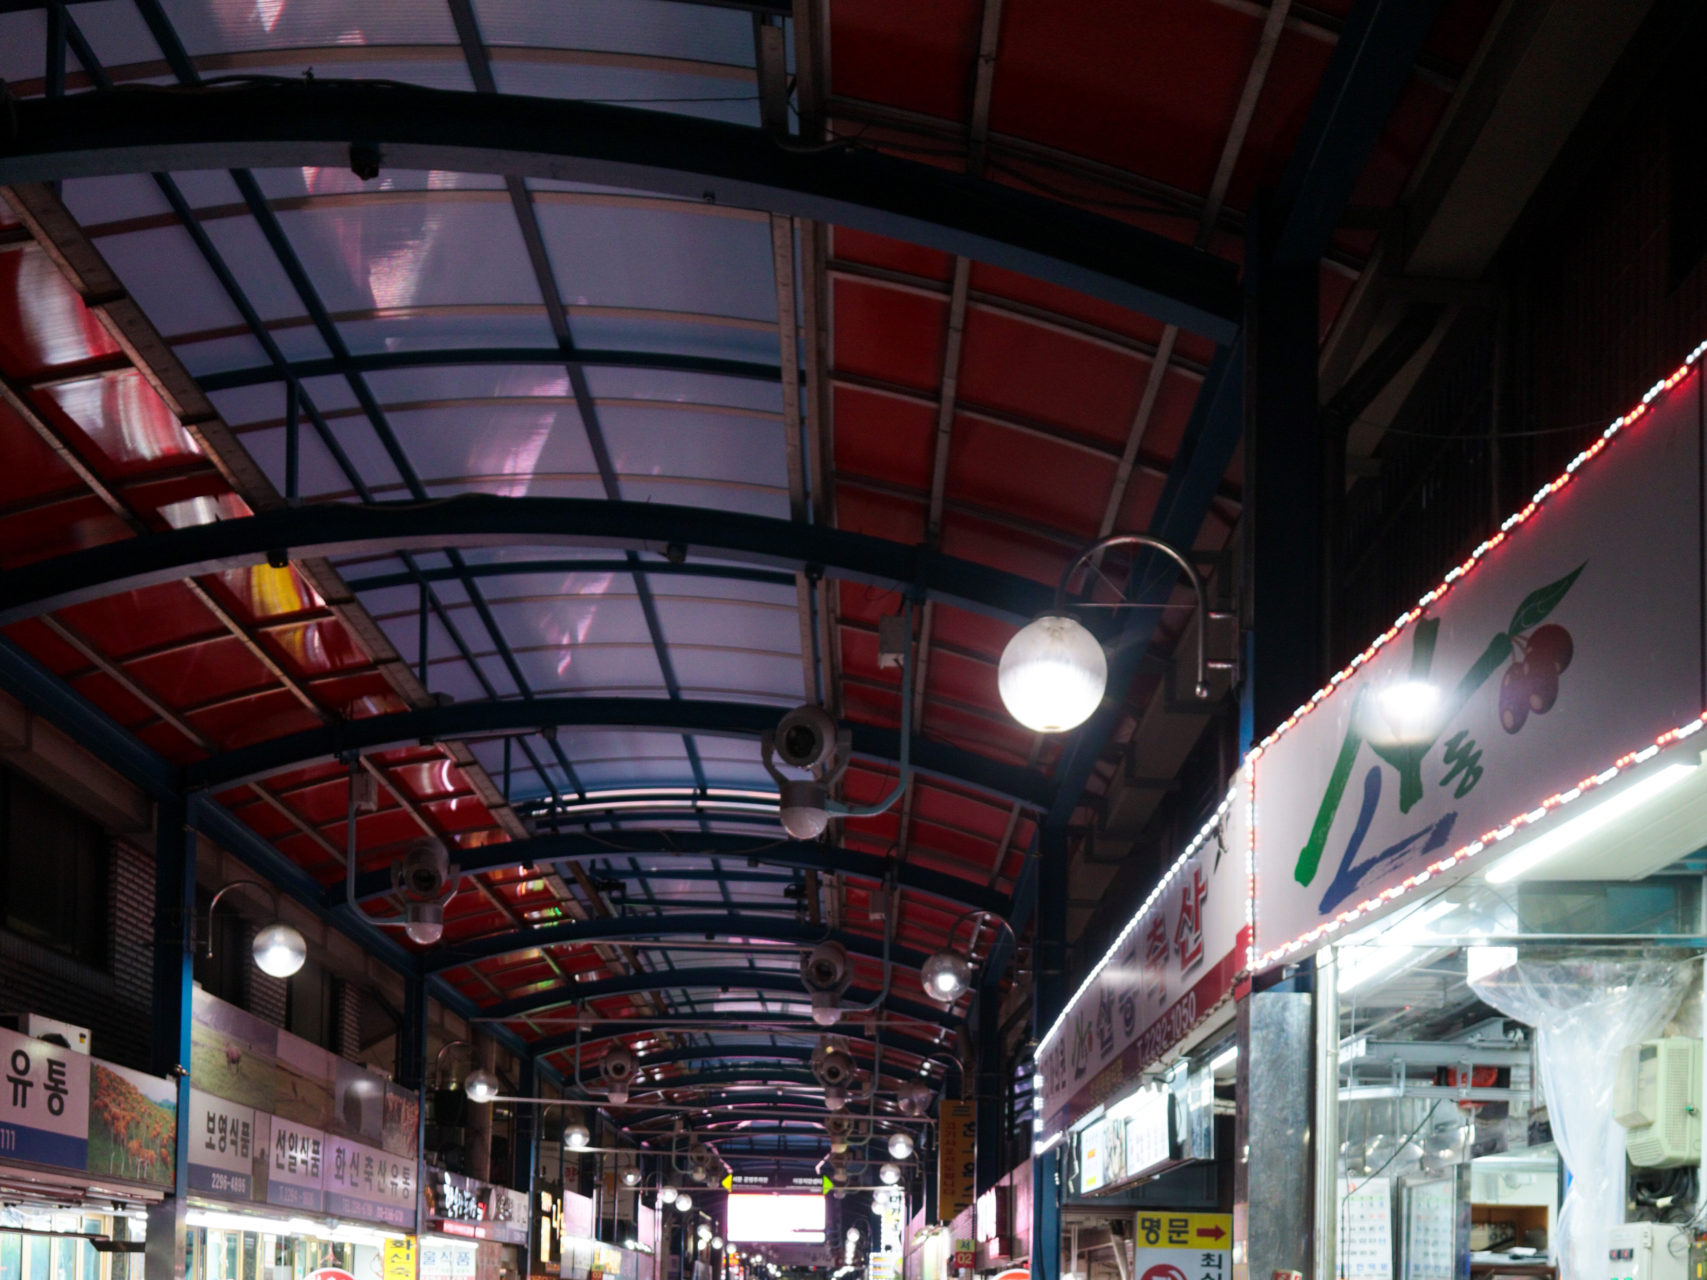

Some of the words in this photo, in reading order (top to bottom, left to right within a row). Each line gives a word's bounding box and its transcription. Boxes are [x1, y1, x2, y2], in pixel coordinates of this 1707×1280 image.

[6, 1049, 69, 1116] 유통
[205, 1111, 250, 1159] 보영식품
[275, 1128, 321, 1178] 선일식품
[334, 1145, 411, 1200] 화신축산유통
[959, 1240, 970, 1250] 서
[1140, 1217, 1190, 1245] 명문
[957, 1253, 973, 1265] 02
